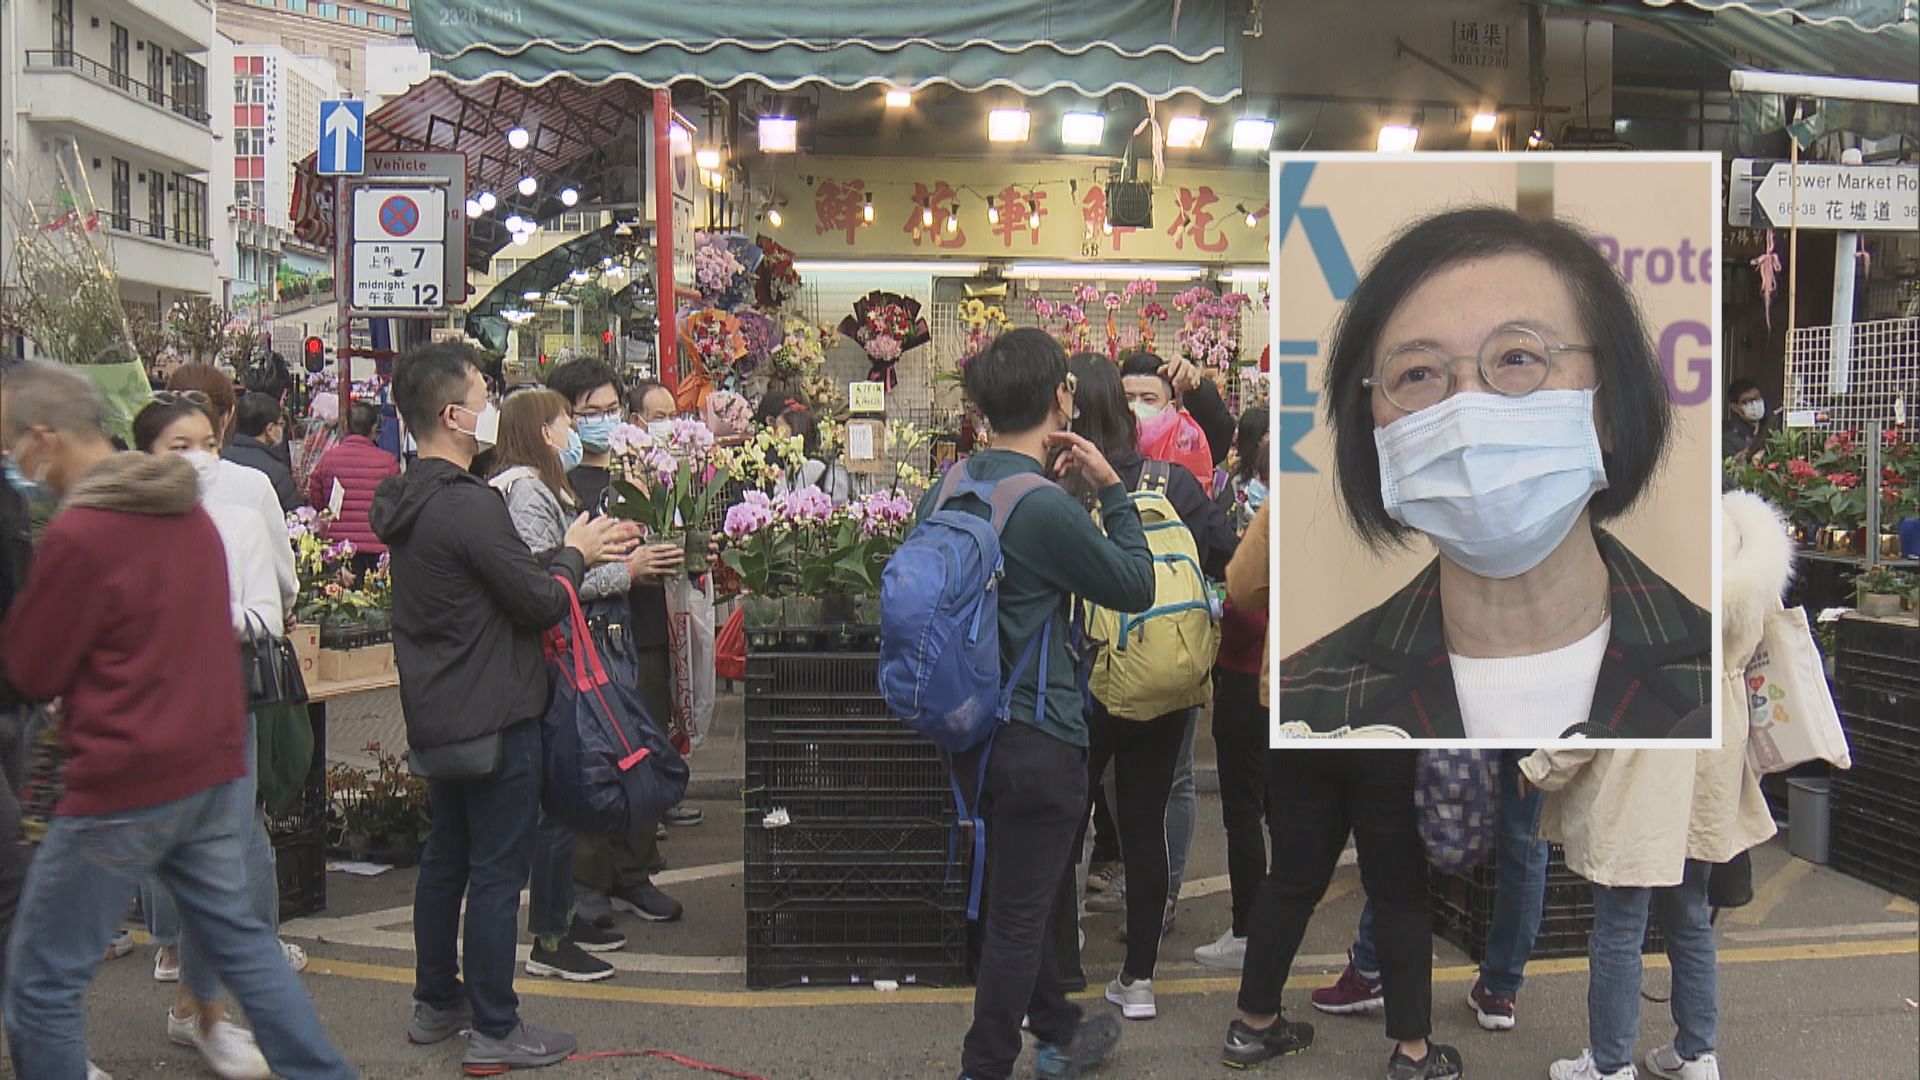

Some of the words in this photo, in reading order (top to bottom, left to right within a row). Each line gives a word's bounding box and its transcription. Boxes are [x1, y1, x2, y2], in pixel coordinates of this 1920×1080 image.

[1460, 22, 1502, 47] 通渠
[374, 157, 427, 171] Vehicle
[1778, 171, 1831, 189] Flower
[1837, 173, 1891, 190] Market
[1826, 200, 1890, 221] 花墟道
[369, 256, 394, 269] 上午
[411, 247, 426, 269] 7
[358, 280, 405, 290] midnight
[412, 283, 439, 305] 12
[368, 291, 395, 305] 午夜
